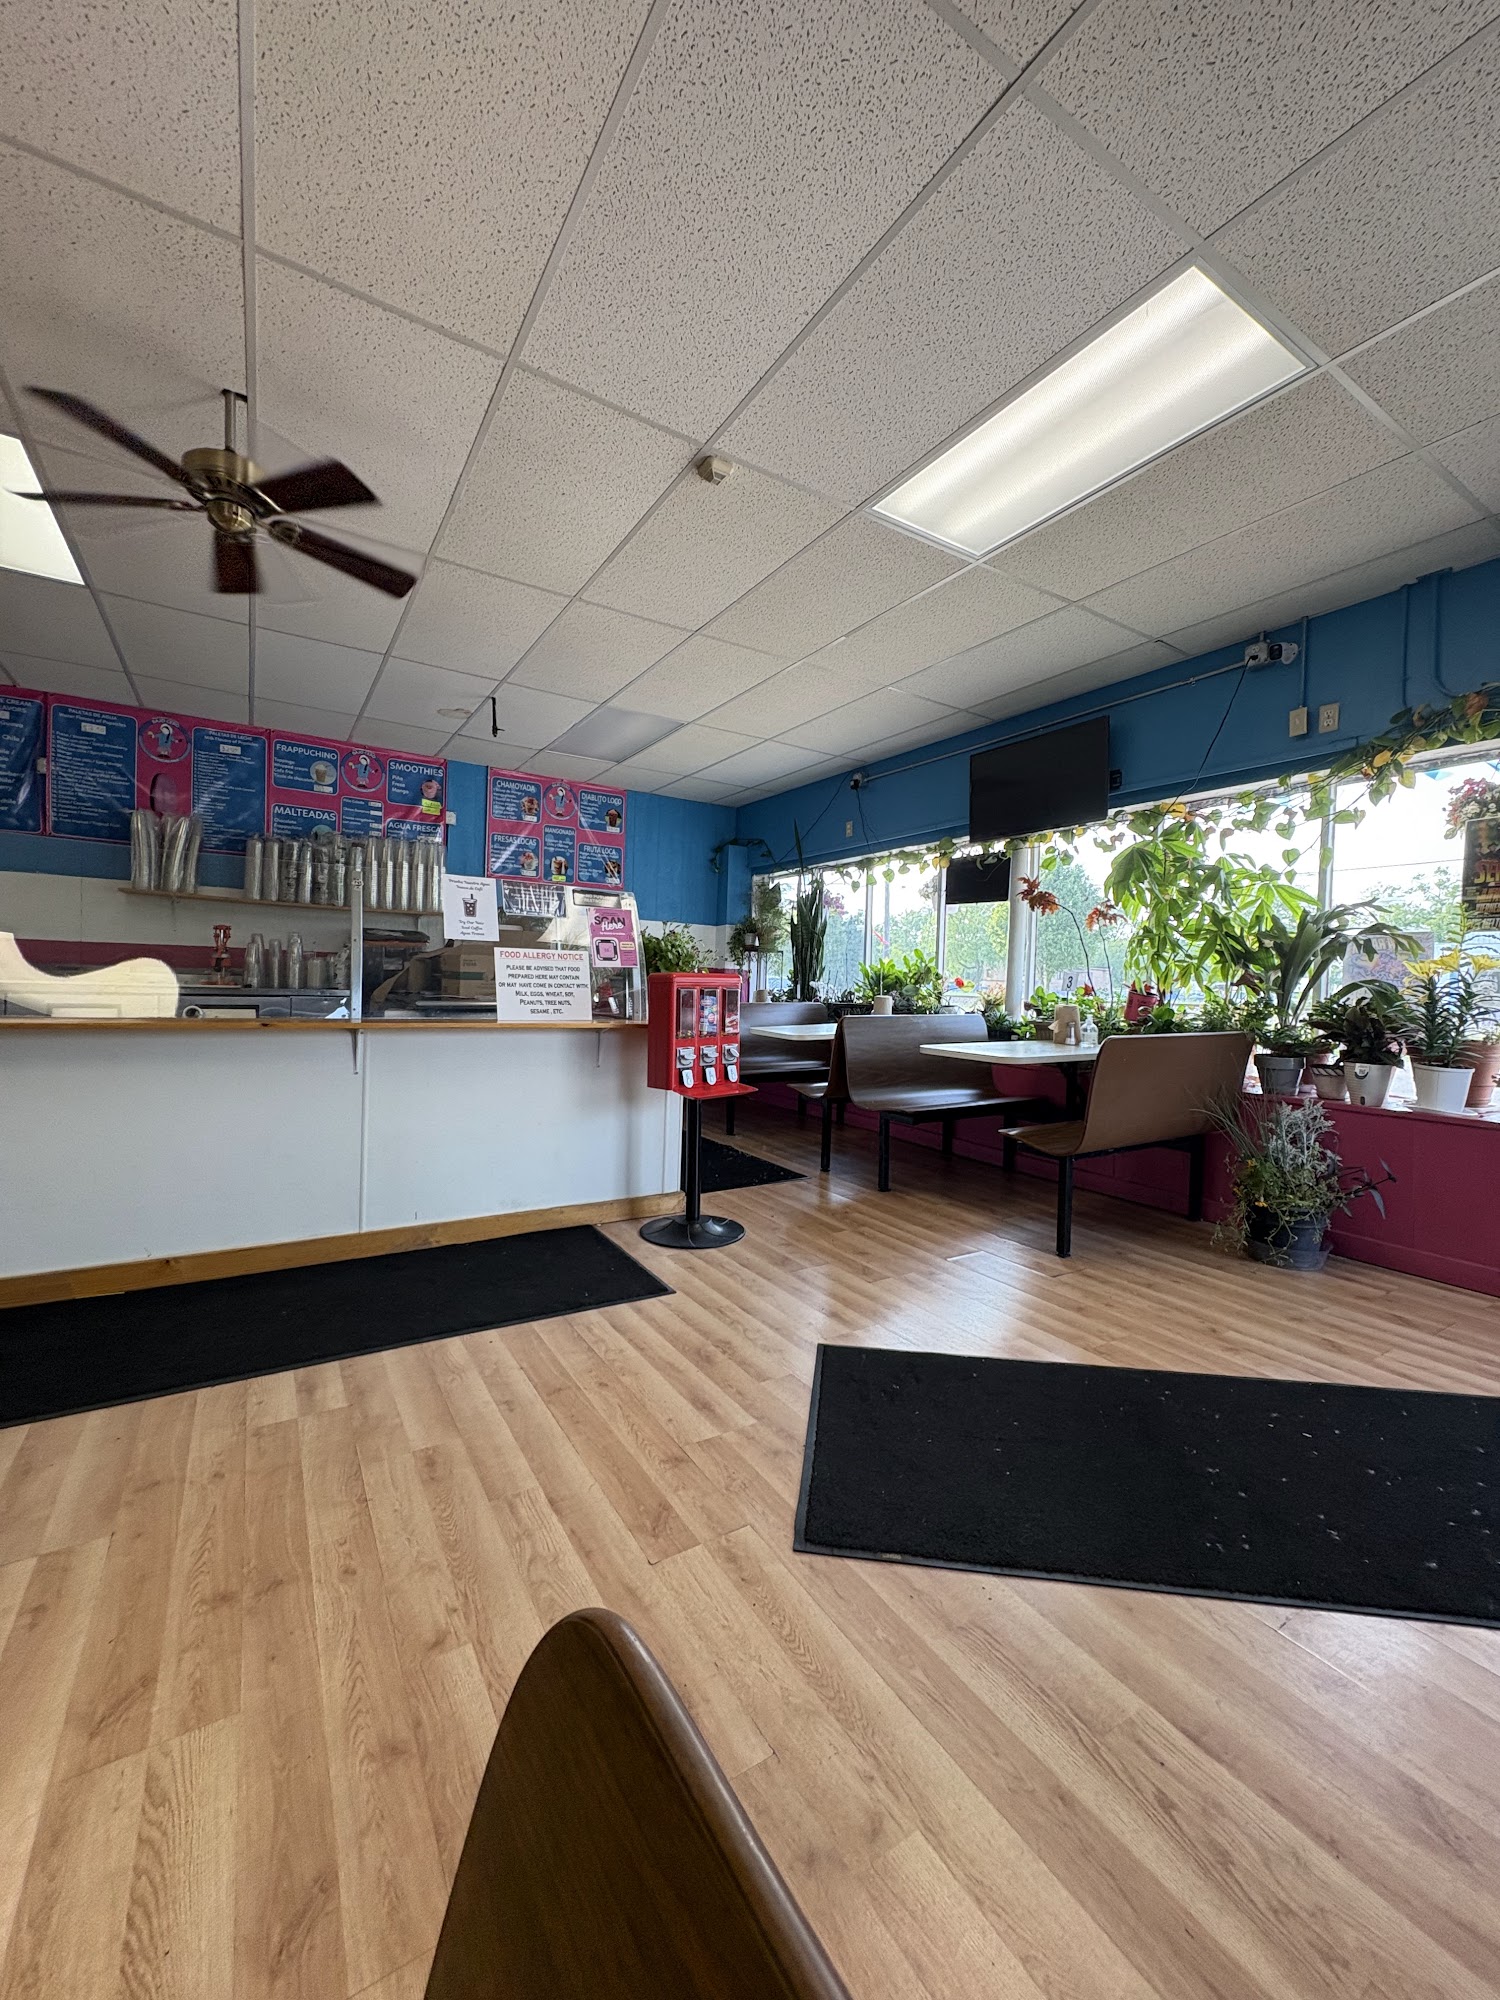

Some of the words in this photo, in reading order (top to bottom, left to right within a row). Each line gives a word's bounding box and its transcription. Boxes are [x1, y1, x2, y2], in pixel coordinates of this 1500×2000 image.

[0, 705, 27, 713] AVORS
[276, 743, 337, 760] FRAPPUCHINO
[390, 762, 443, 777] SMOOTHIES
[496, 780, 535, 792] CHAMOYADA
[581, 793, 606, 803] DIABLITO
[607, 797, 622, 805] LOCO
[274, 806, 336, 821] MALTEADAS
[388, 822, 411, 830] AGUA
[412, 824, 441, 833] FRESCA
[494, 835, 517, 844] FRESAS
[517, 837, 537, 846] LOCAS
[583, 845, 601, 853] FRUTA
[594, 915, 626, 926] SCAN
[601, 920, 624, 931] Here
[523, 952, 556, 960] ALLERGY
[557, 953, 584, 961] NOTICE
[1067, 976, 1073, 989] 3
